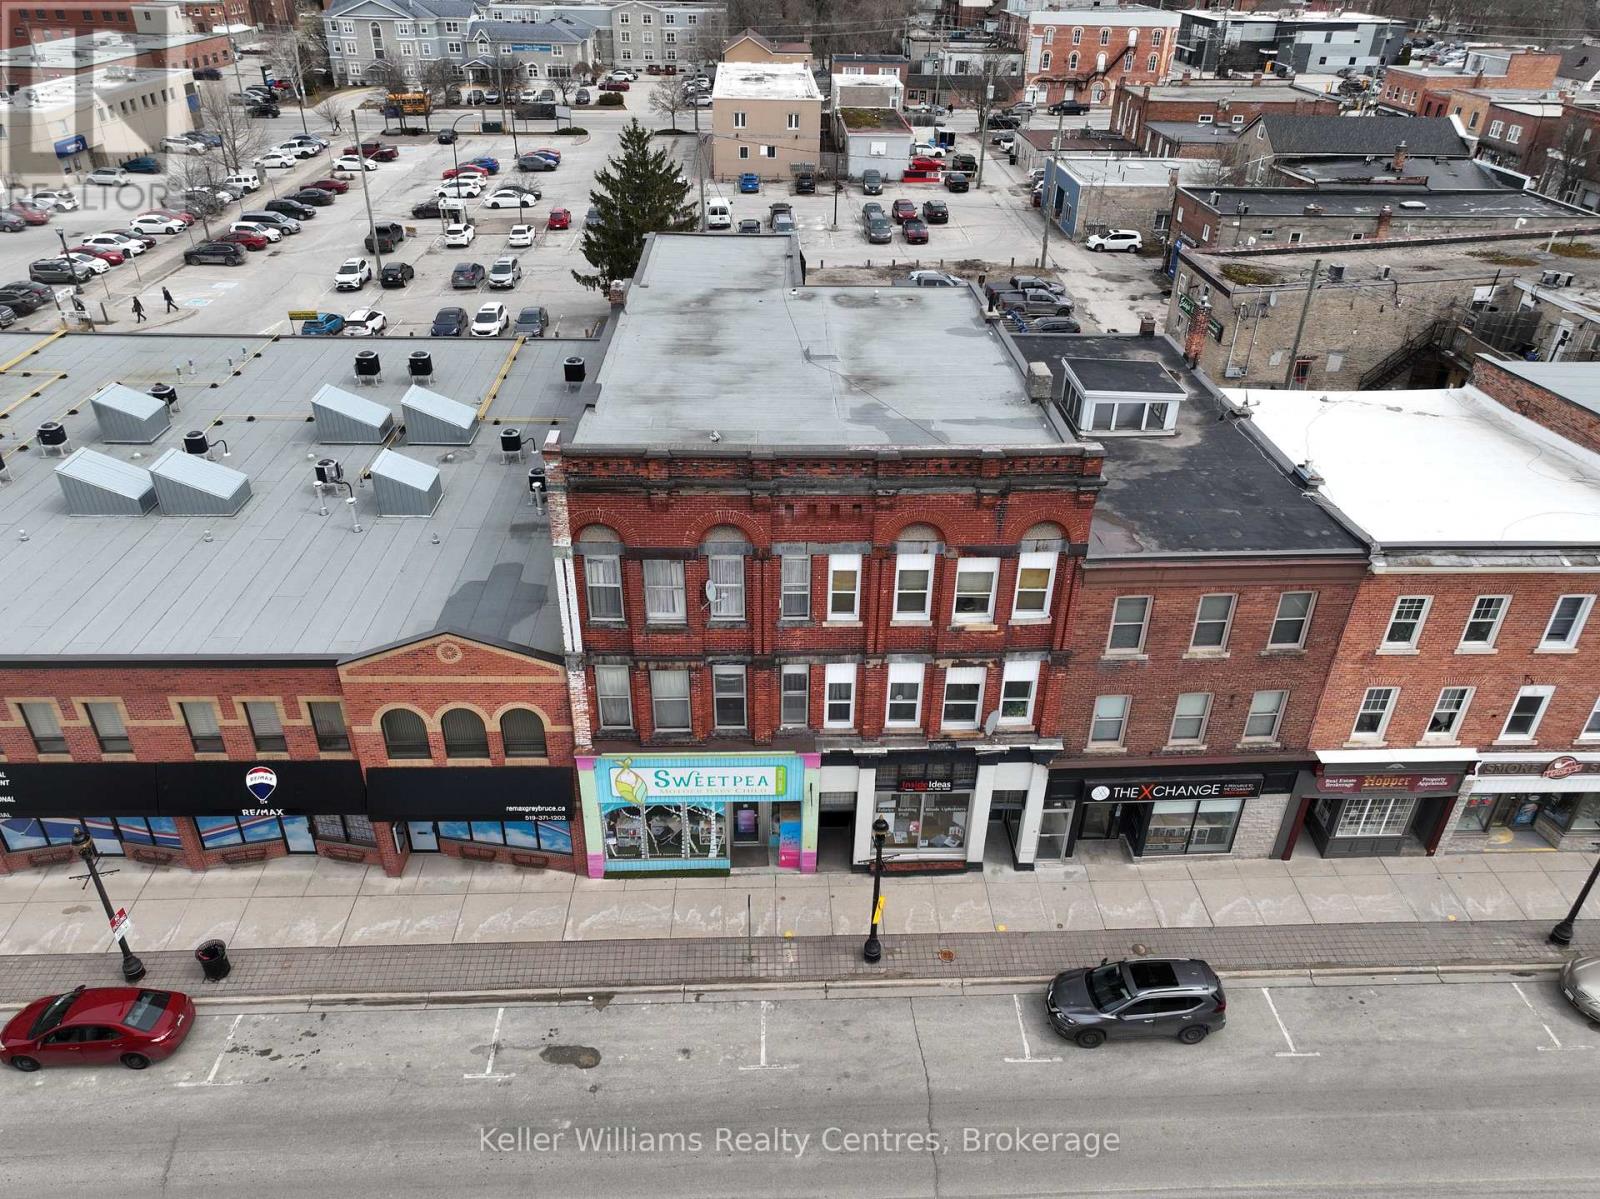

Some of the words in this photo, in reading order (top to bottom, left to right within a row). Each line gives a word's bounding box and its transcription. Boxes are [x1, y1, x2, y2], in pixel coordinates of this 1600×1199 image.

[1485, 763, 1539, 773] SMOKE
[1362, 775, 1411, 787] Hopper
[241, 808, 284, 816] RE/MAX
[505, 804, 566, 812] remaxgreybruce.ca
